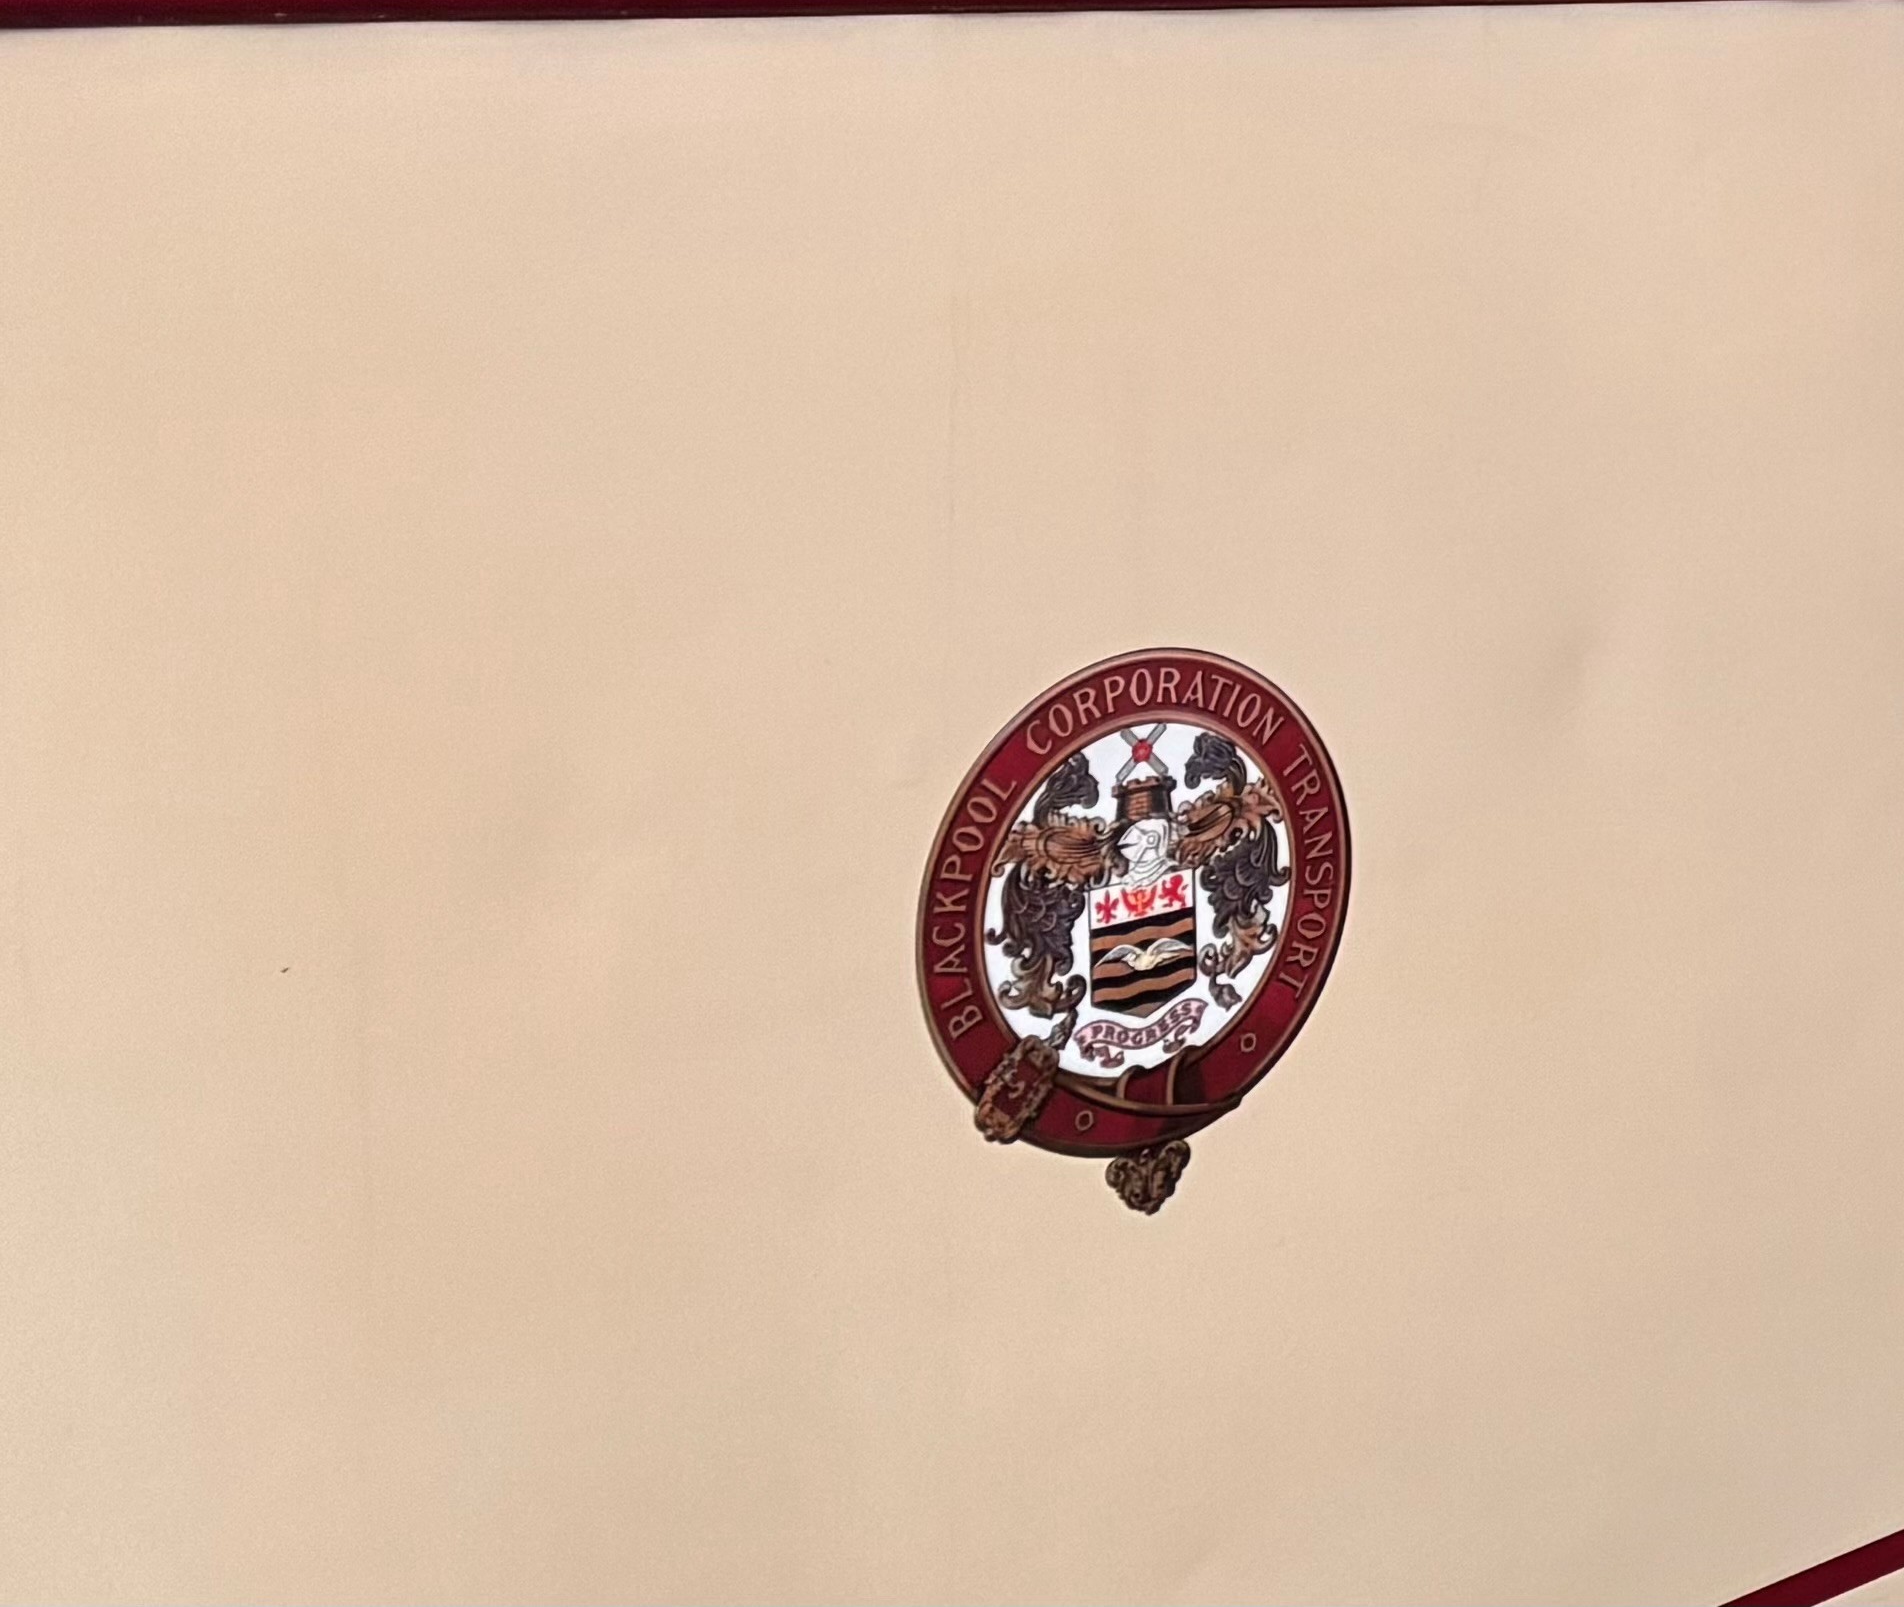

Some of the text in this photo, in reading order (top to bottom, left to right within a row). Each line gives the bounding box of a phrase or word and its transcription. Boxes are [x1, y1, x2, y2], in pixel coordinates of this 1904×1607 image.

[931, 666, 1335, 1040] BLACKPOOL CORPORATION TRANSPORT
[1090, 1002, 1193, 1045] PROGRESS
